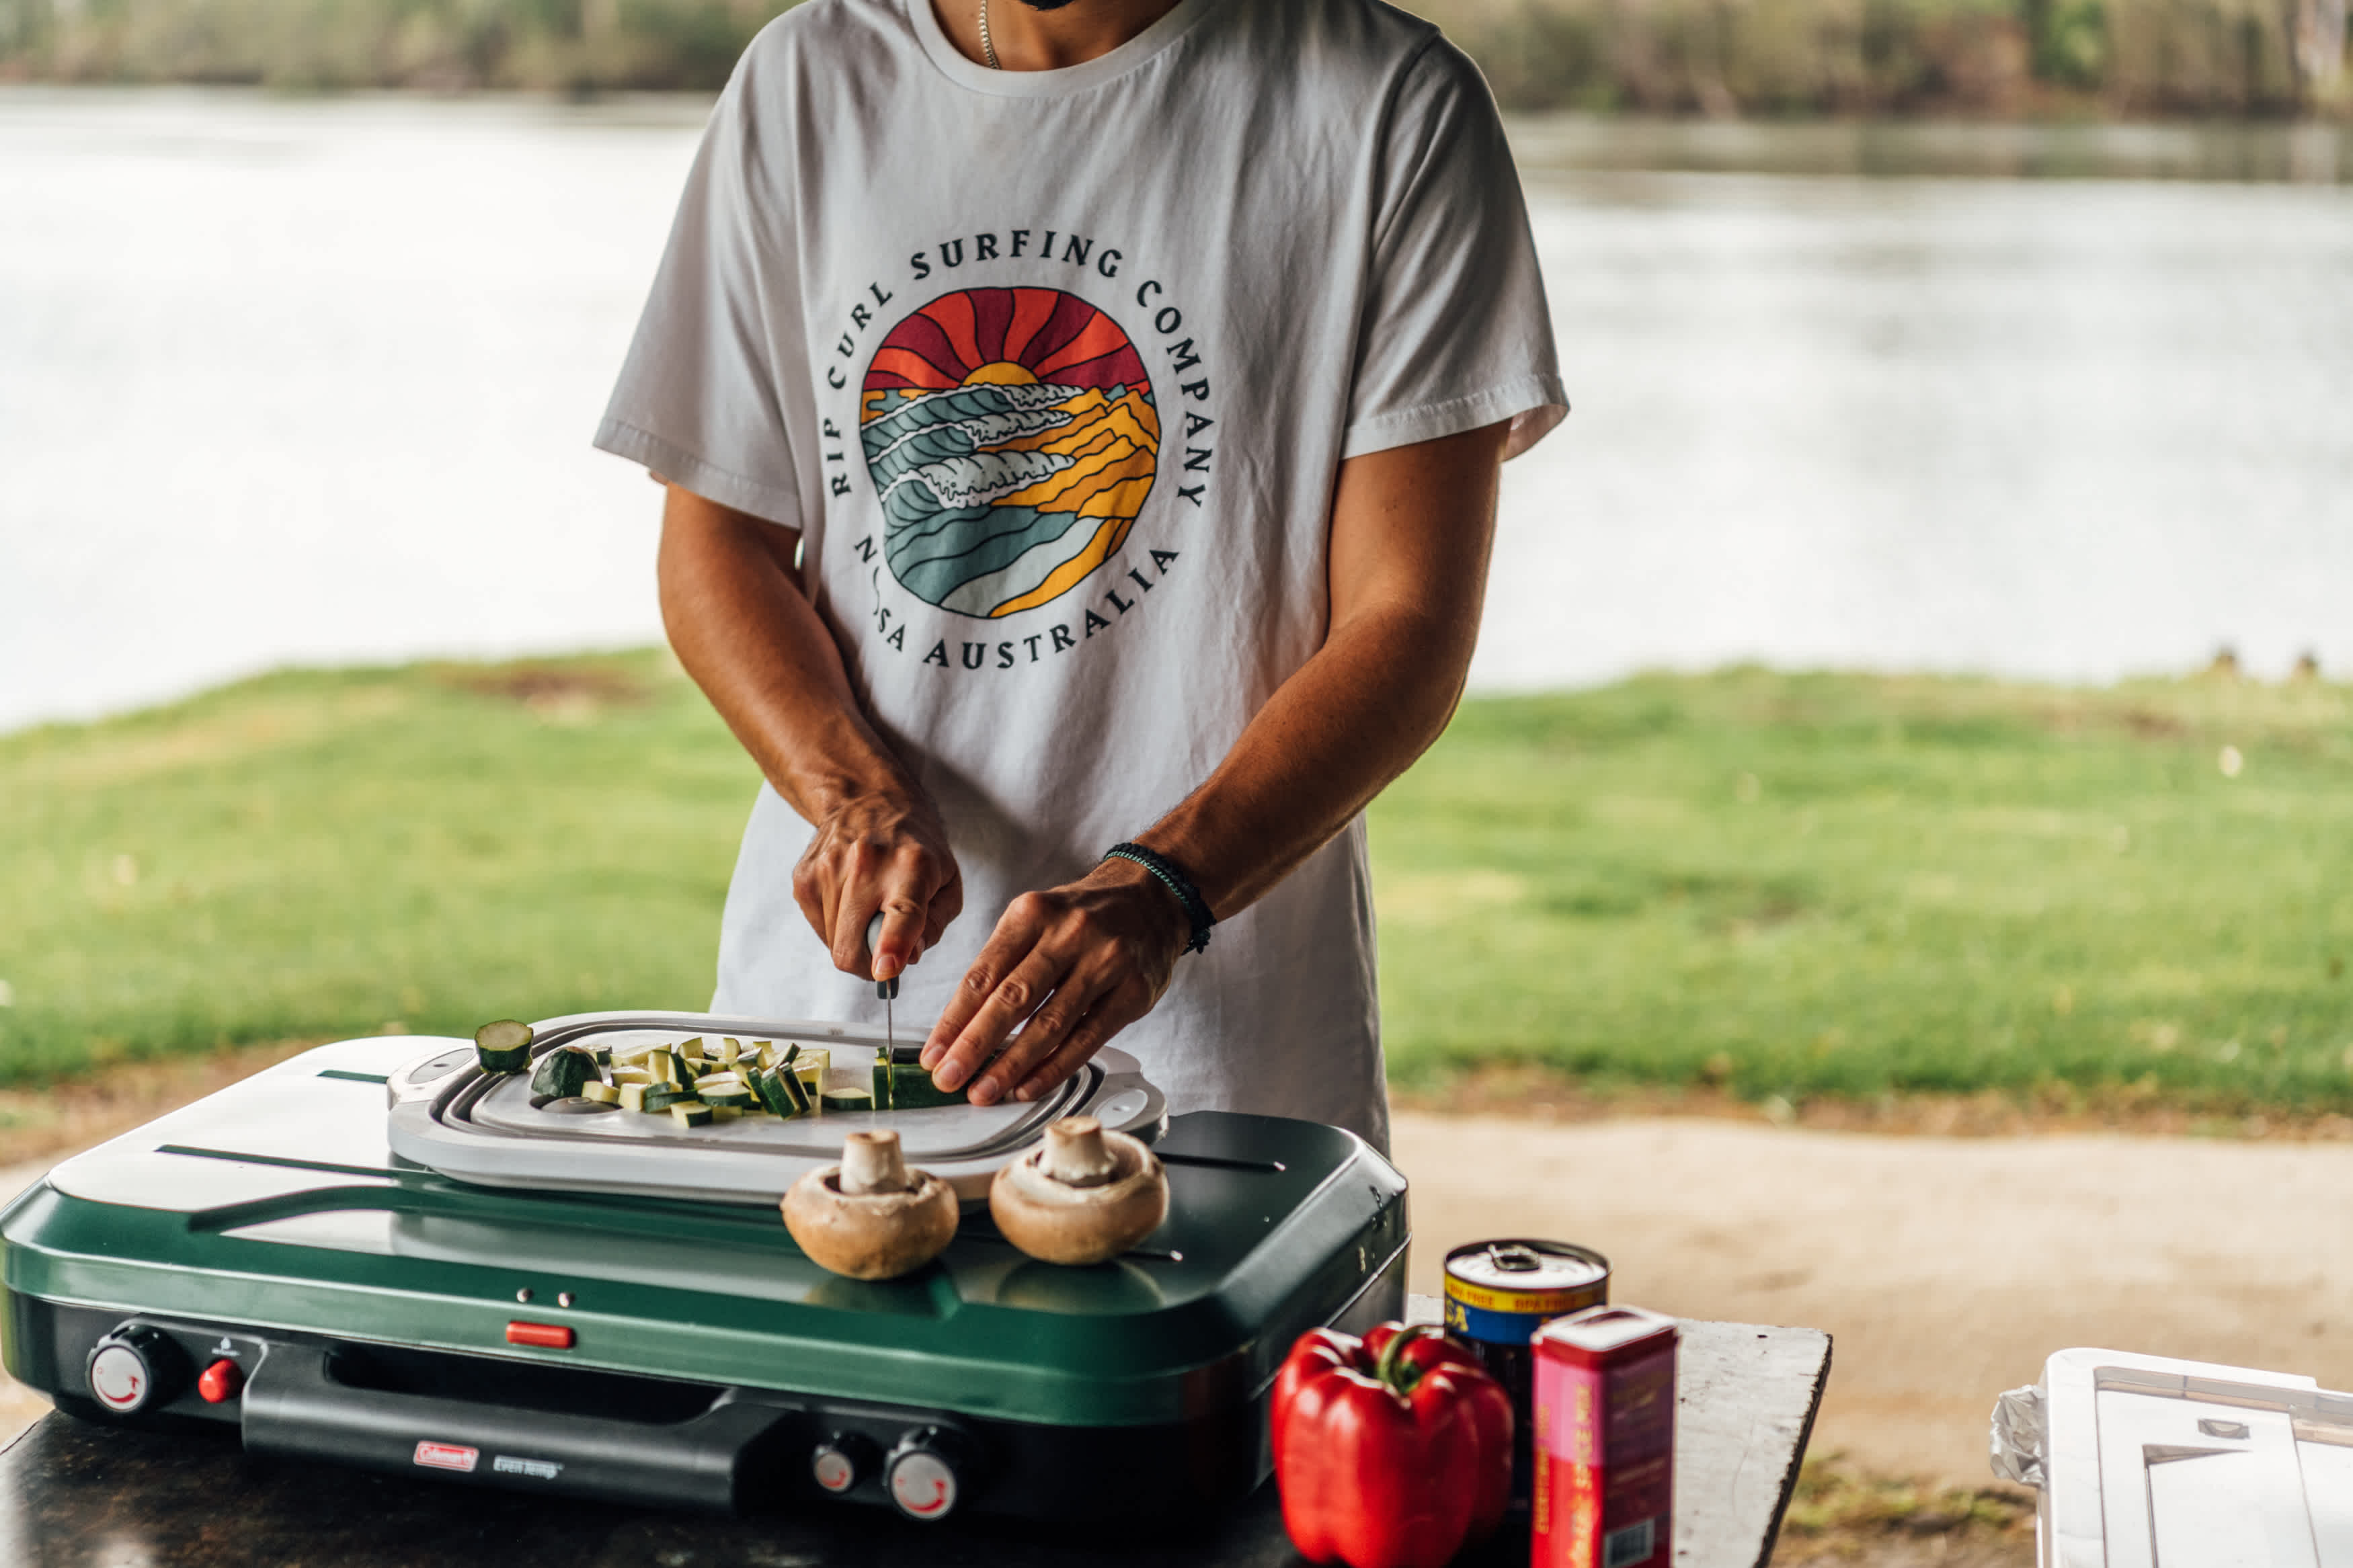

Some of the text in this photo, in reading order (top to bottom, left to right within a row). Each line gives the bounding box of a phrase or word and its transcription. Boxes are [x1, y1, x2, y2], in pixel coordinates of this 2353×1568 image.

[824, 229, 1215, 508] RIP CURL SURFING COMPANY
[853, 534, 1181, 670] NSA AUSTRALIA
